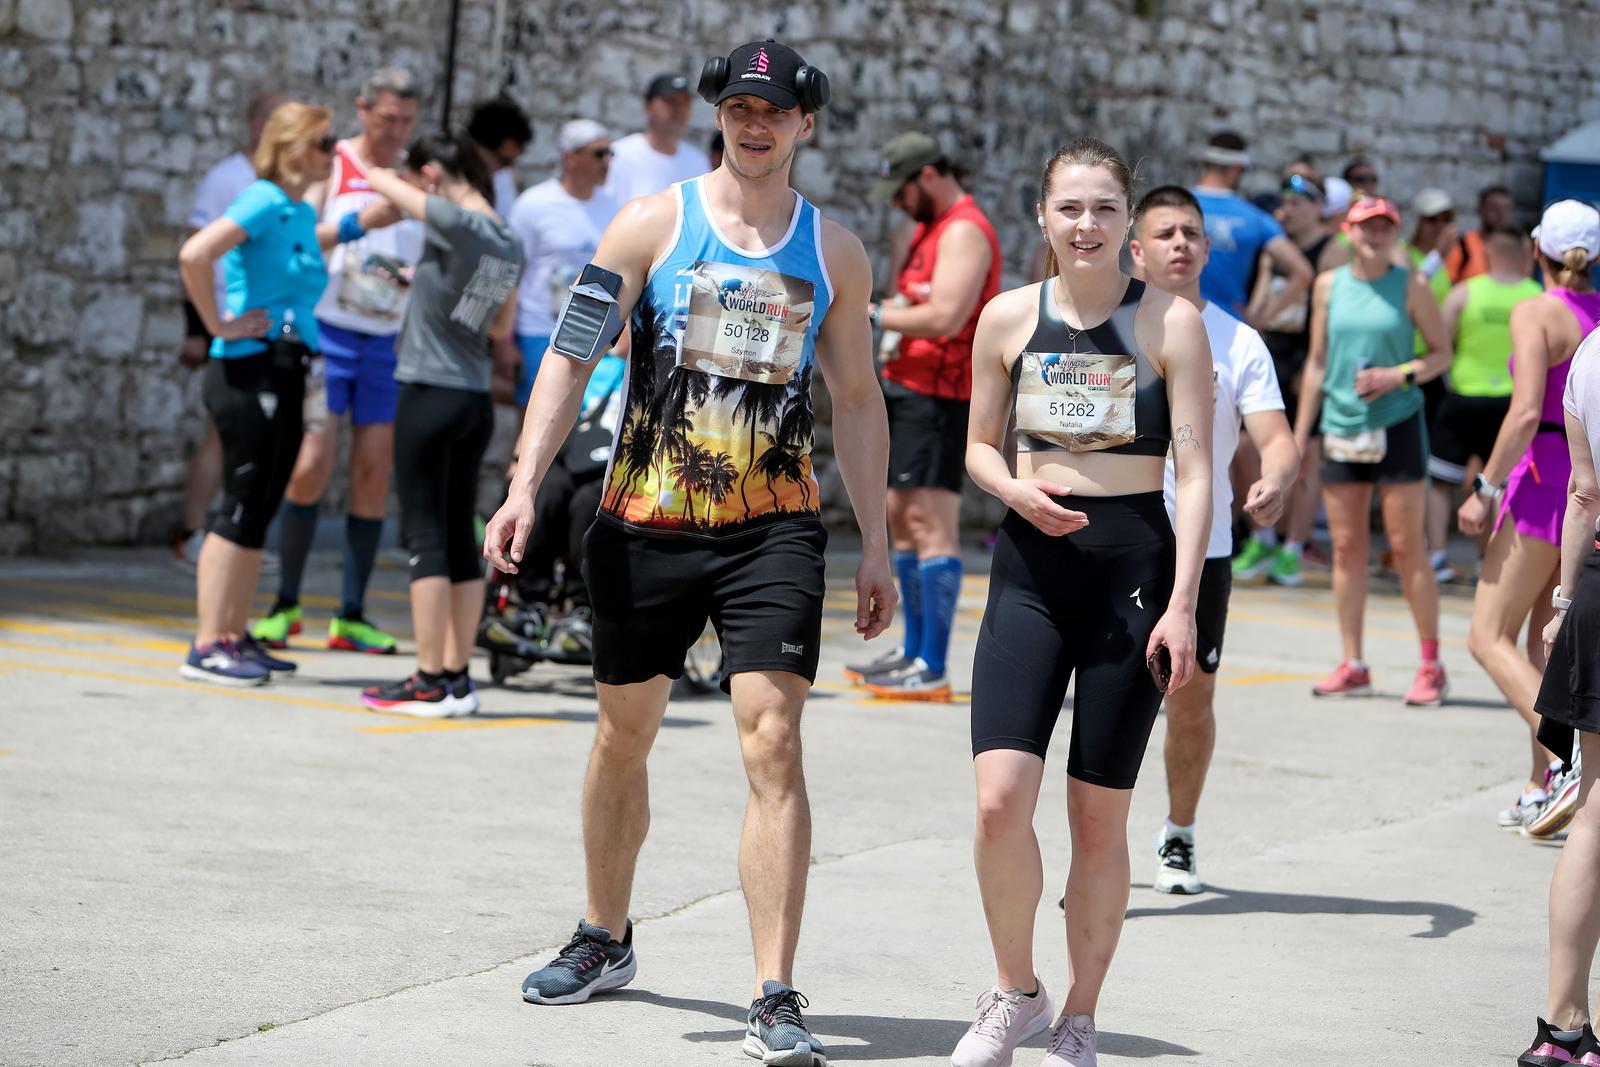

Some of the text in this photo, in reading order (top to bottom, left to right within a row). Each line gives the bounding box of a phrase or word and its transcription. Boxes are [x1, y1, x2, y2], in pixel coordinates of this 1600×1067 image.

[729, 297, 789, 318] WORLD RUN
[724, 323, 770, 343] 50128
[730, 346, 757, 356] Szymon
[1060, 360, 1086, 368] WINGS
[1050, 371, 1111, 386] WORLD RUN
[1049, 402, 1095, 417] 51262
[1059, 421, 1083, 429] Natalia
